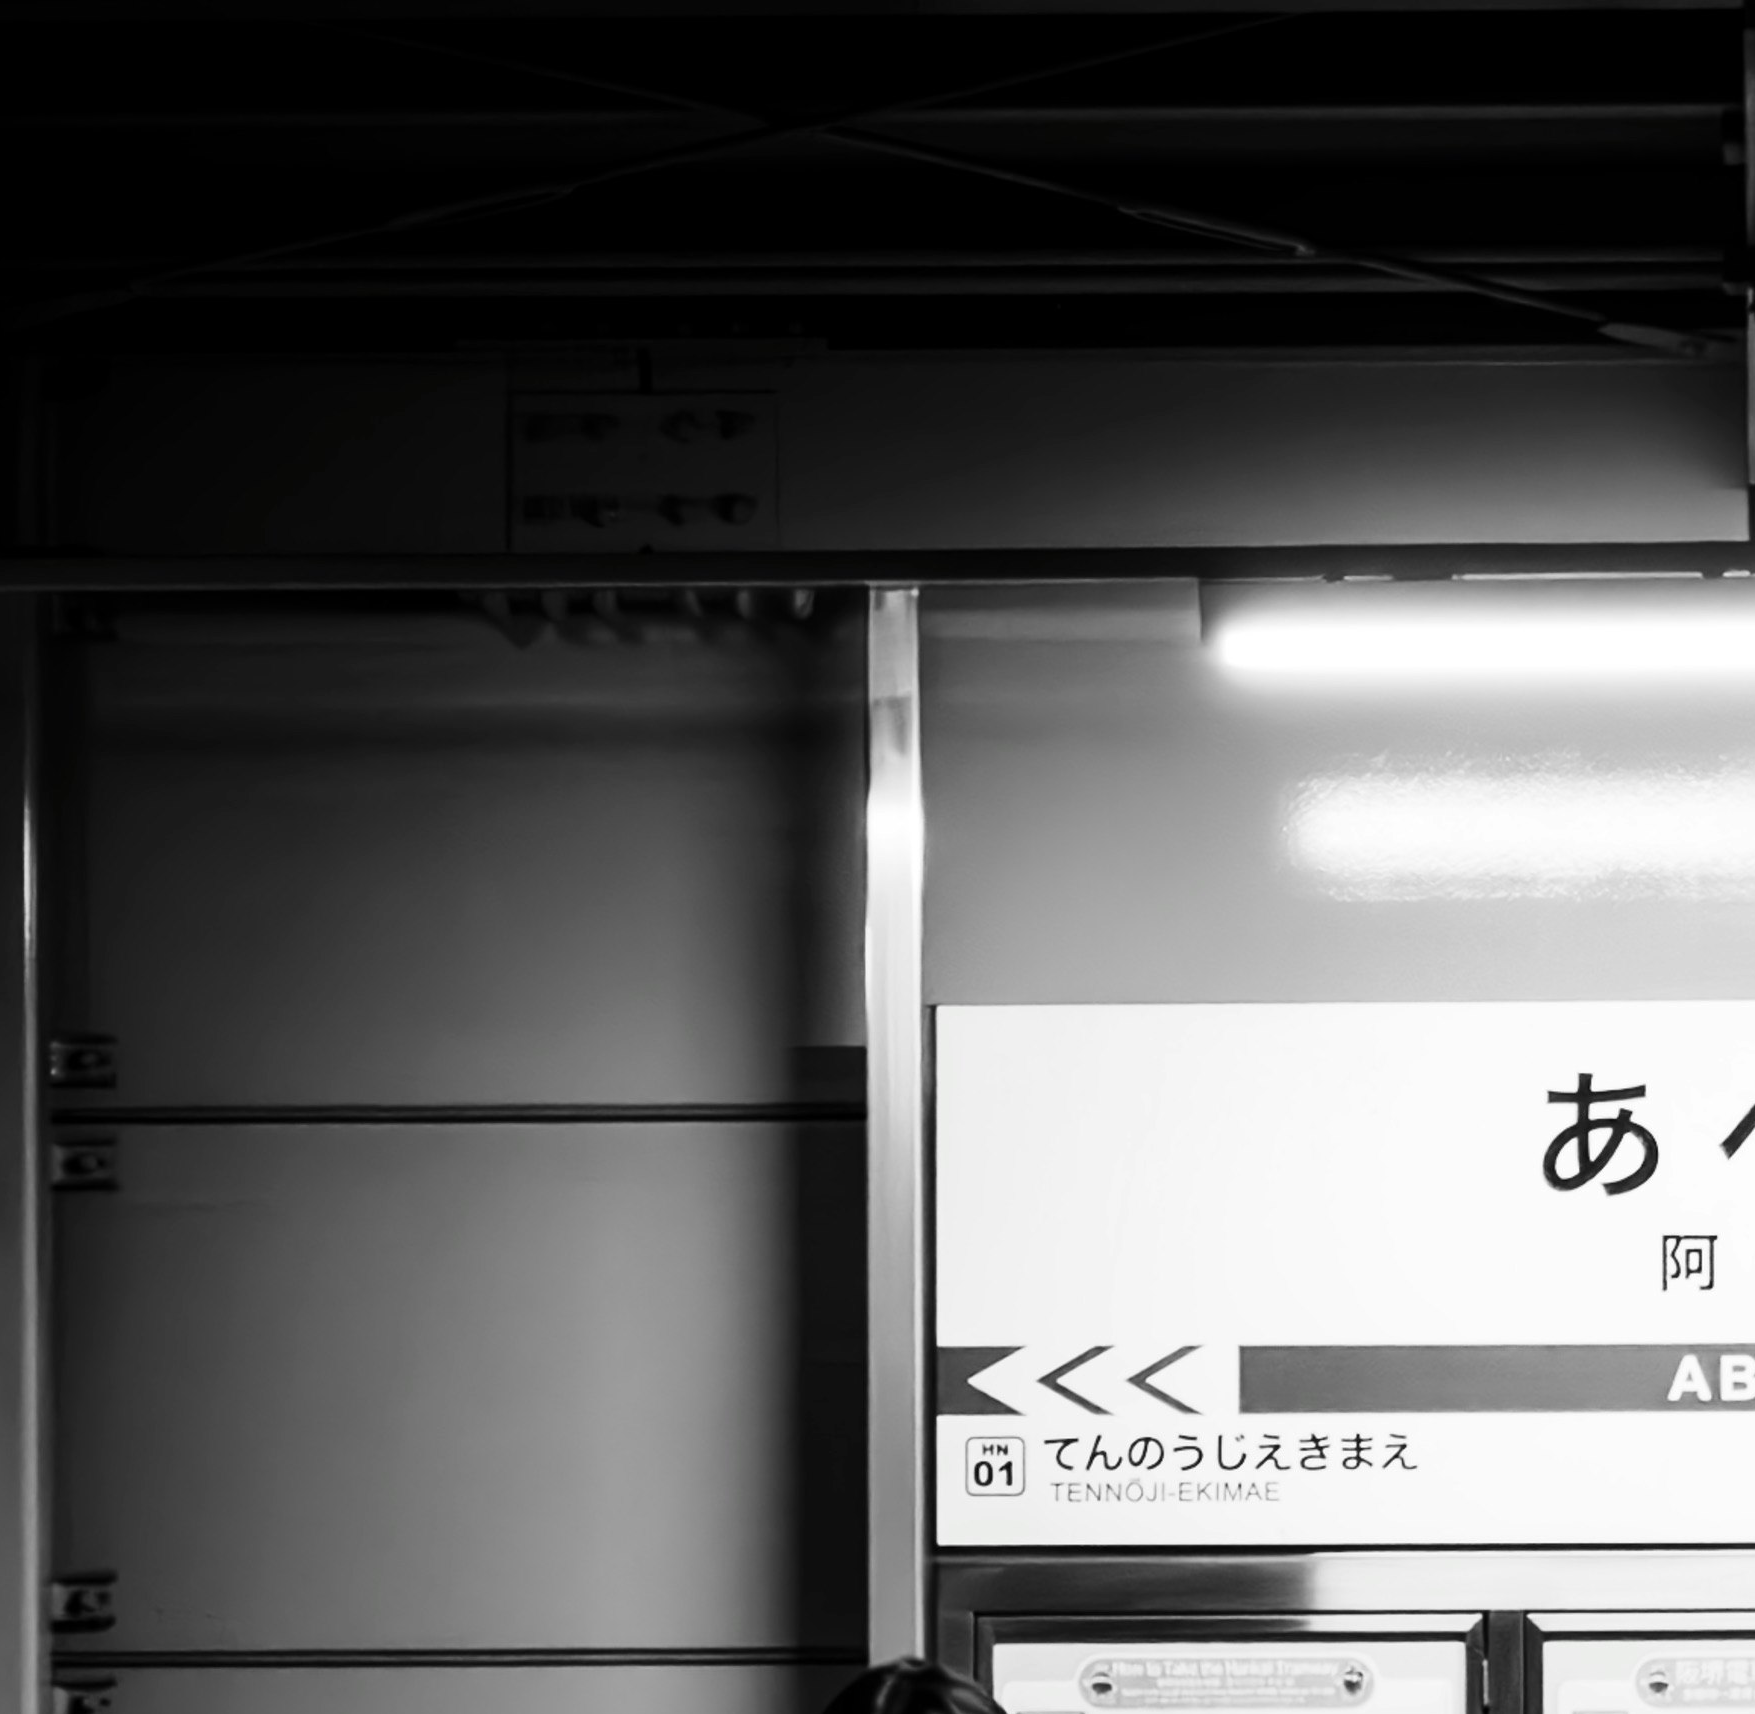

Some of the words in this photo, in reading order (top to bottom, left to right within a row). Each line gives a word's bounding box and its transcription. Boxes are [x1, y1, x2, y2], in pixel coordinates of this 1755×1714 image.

[981, 1443, 1009, 1456] HN
[1044, 1434, 1418, 1471] てんのうじえきまえ
[973, 1460, 1013, 1487] 01
